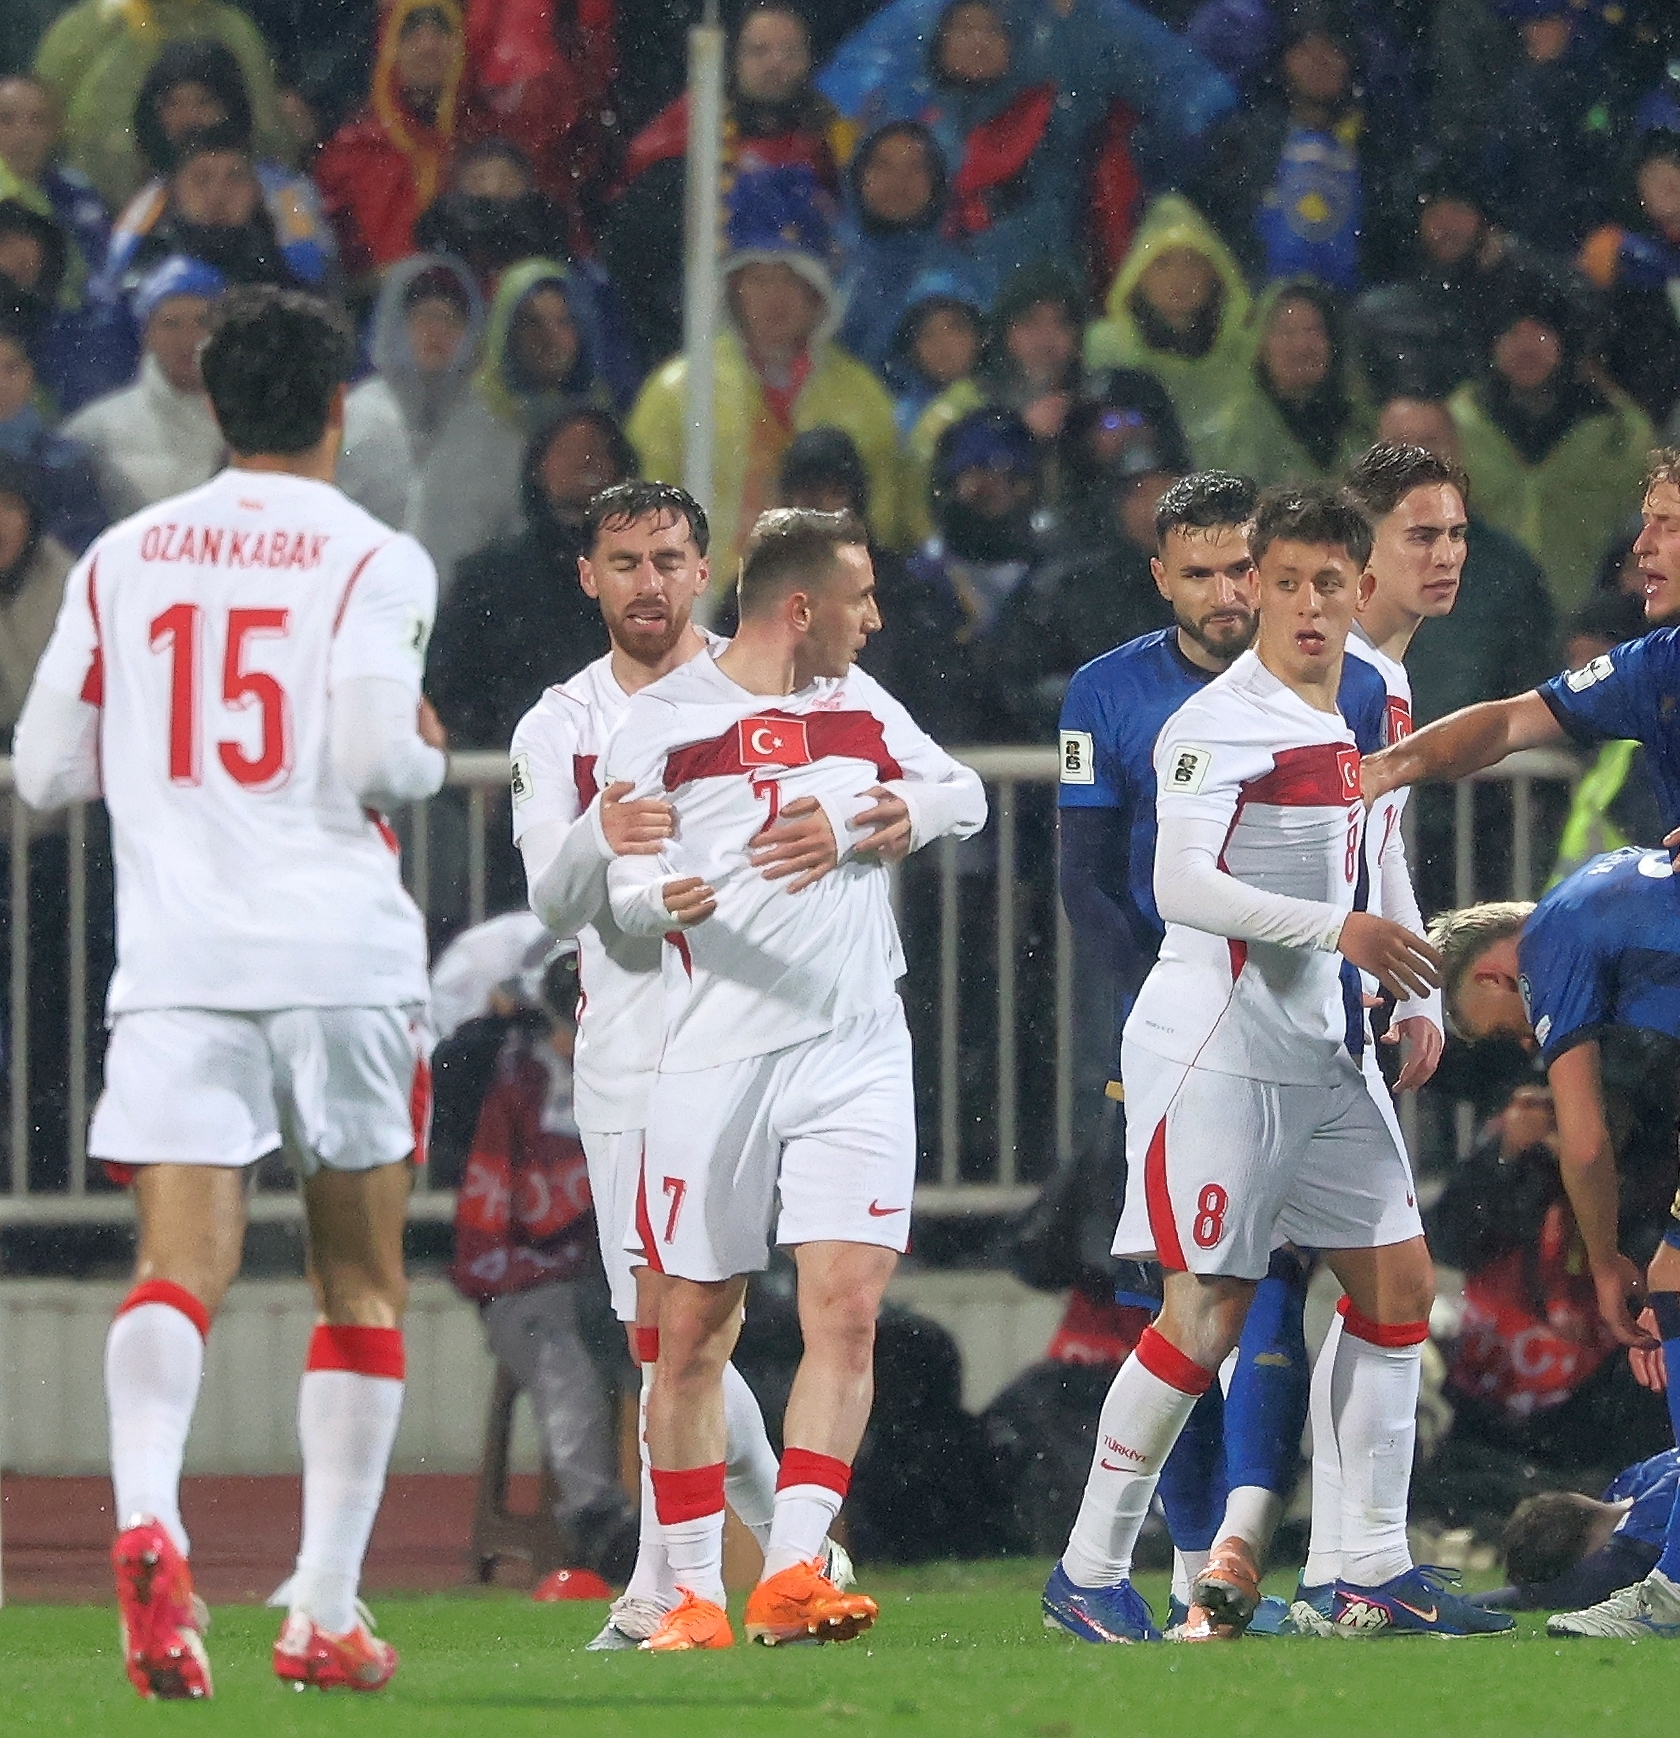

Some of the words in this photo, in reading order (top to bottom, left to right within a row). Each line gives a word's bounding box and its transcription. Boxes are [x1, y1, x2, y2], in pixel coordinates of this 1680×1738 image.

[140, 524, 224, 567] OZAN
[227, 529, 331, 572] KABAK
[148, 603, 297, 793] 15
[662, 1175, 687, 1246] 7
[1192, 1183, 1229, 1251] 8
